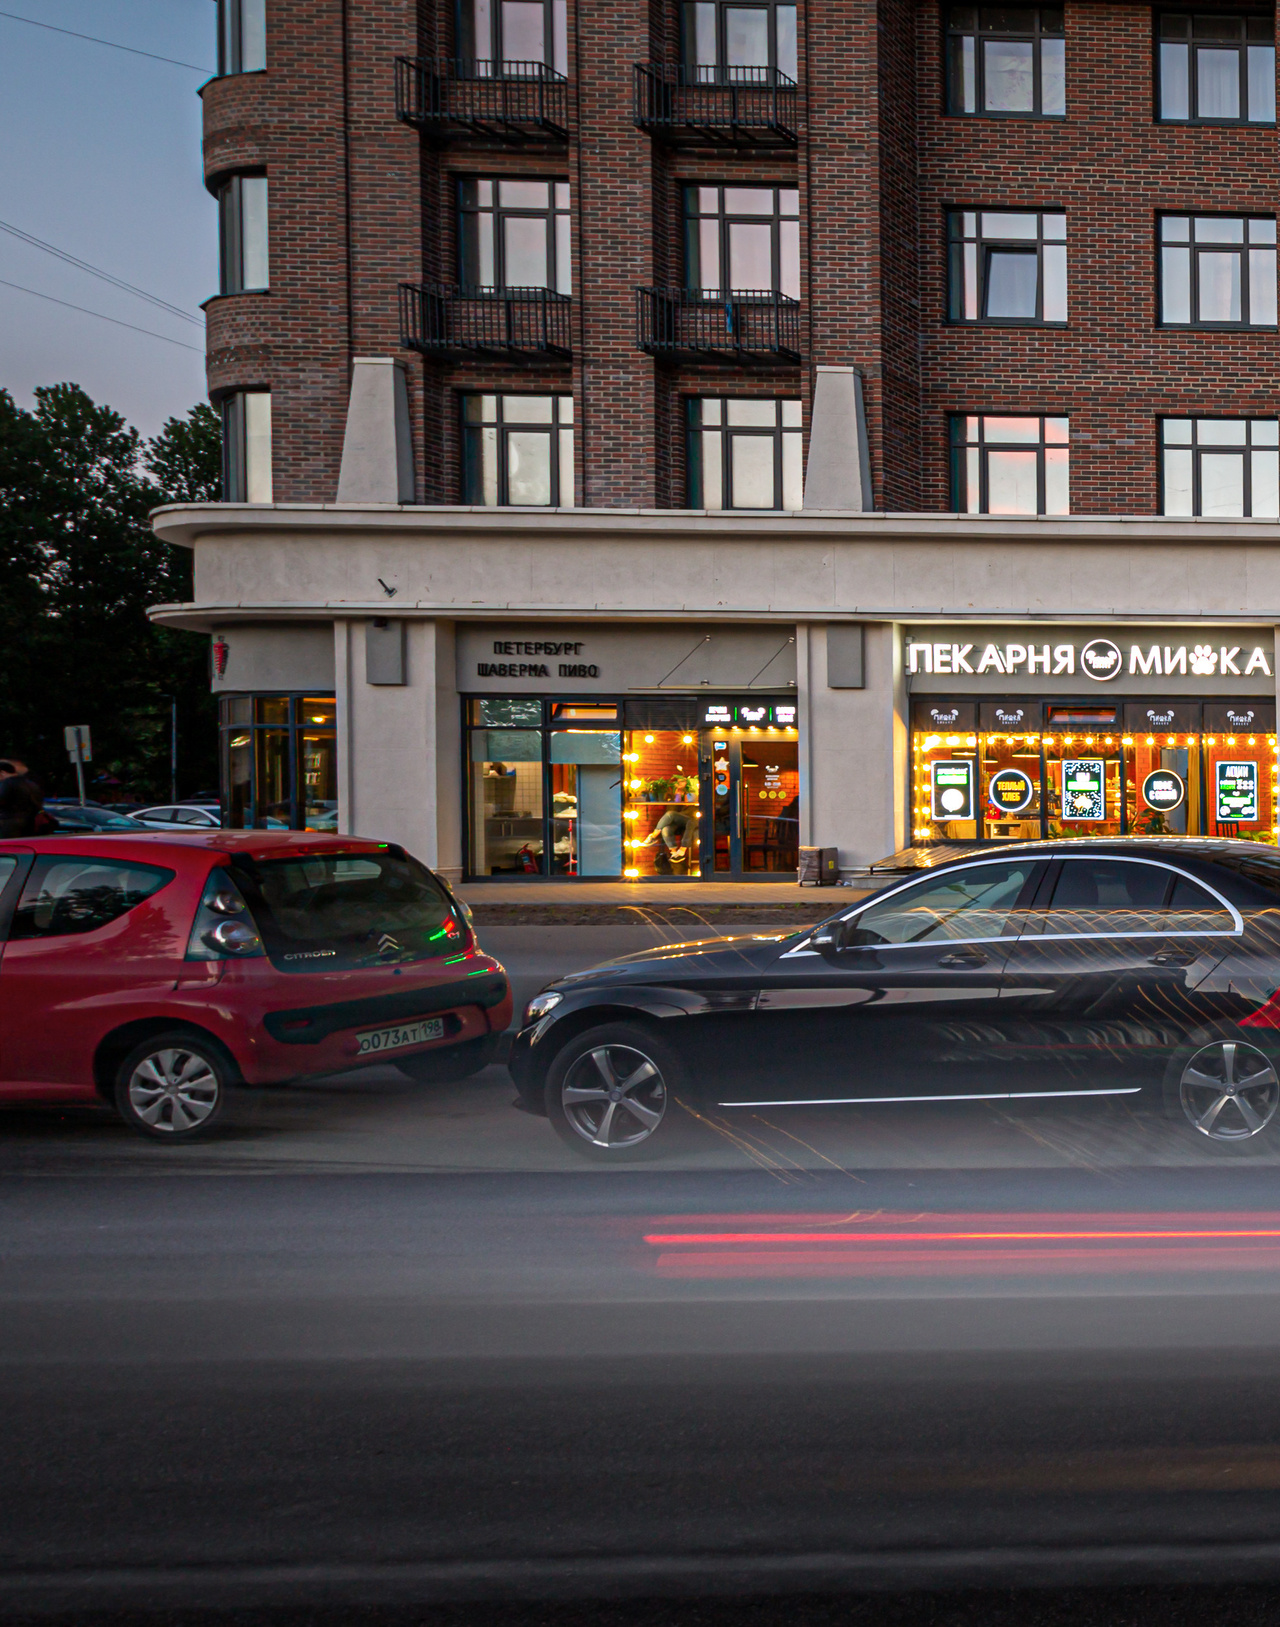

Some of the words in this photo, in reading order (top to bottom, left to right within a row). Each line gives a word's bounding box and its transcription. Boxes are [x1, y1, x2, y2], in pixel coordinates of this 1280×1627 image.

[493, 641, 585, 655] ПЕТЕРБУРГ
[909, 643, 1075, 675] ПЕКАРНЯ
[477, 663, 550, 677] ШАВЕРМА
[558, 664, 600, 678] ПИВО
[997, 780, 1025, 791] ТЕПЛЫЙ
[1002, 792, 1021, 802] ХЛЕБ
